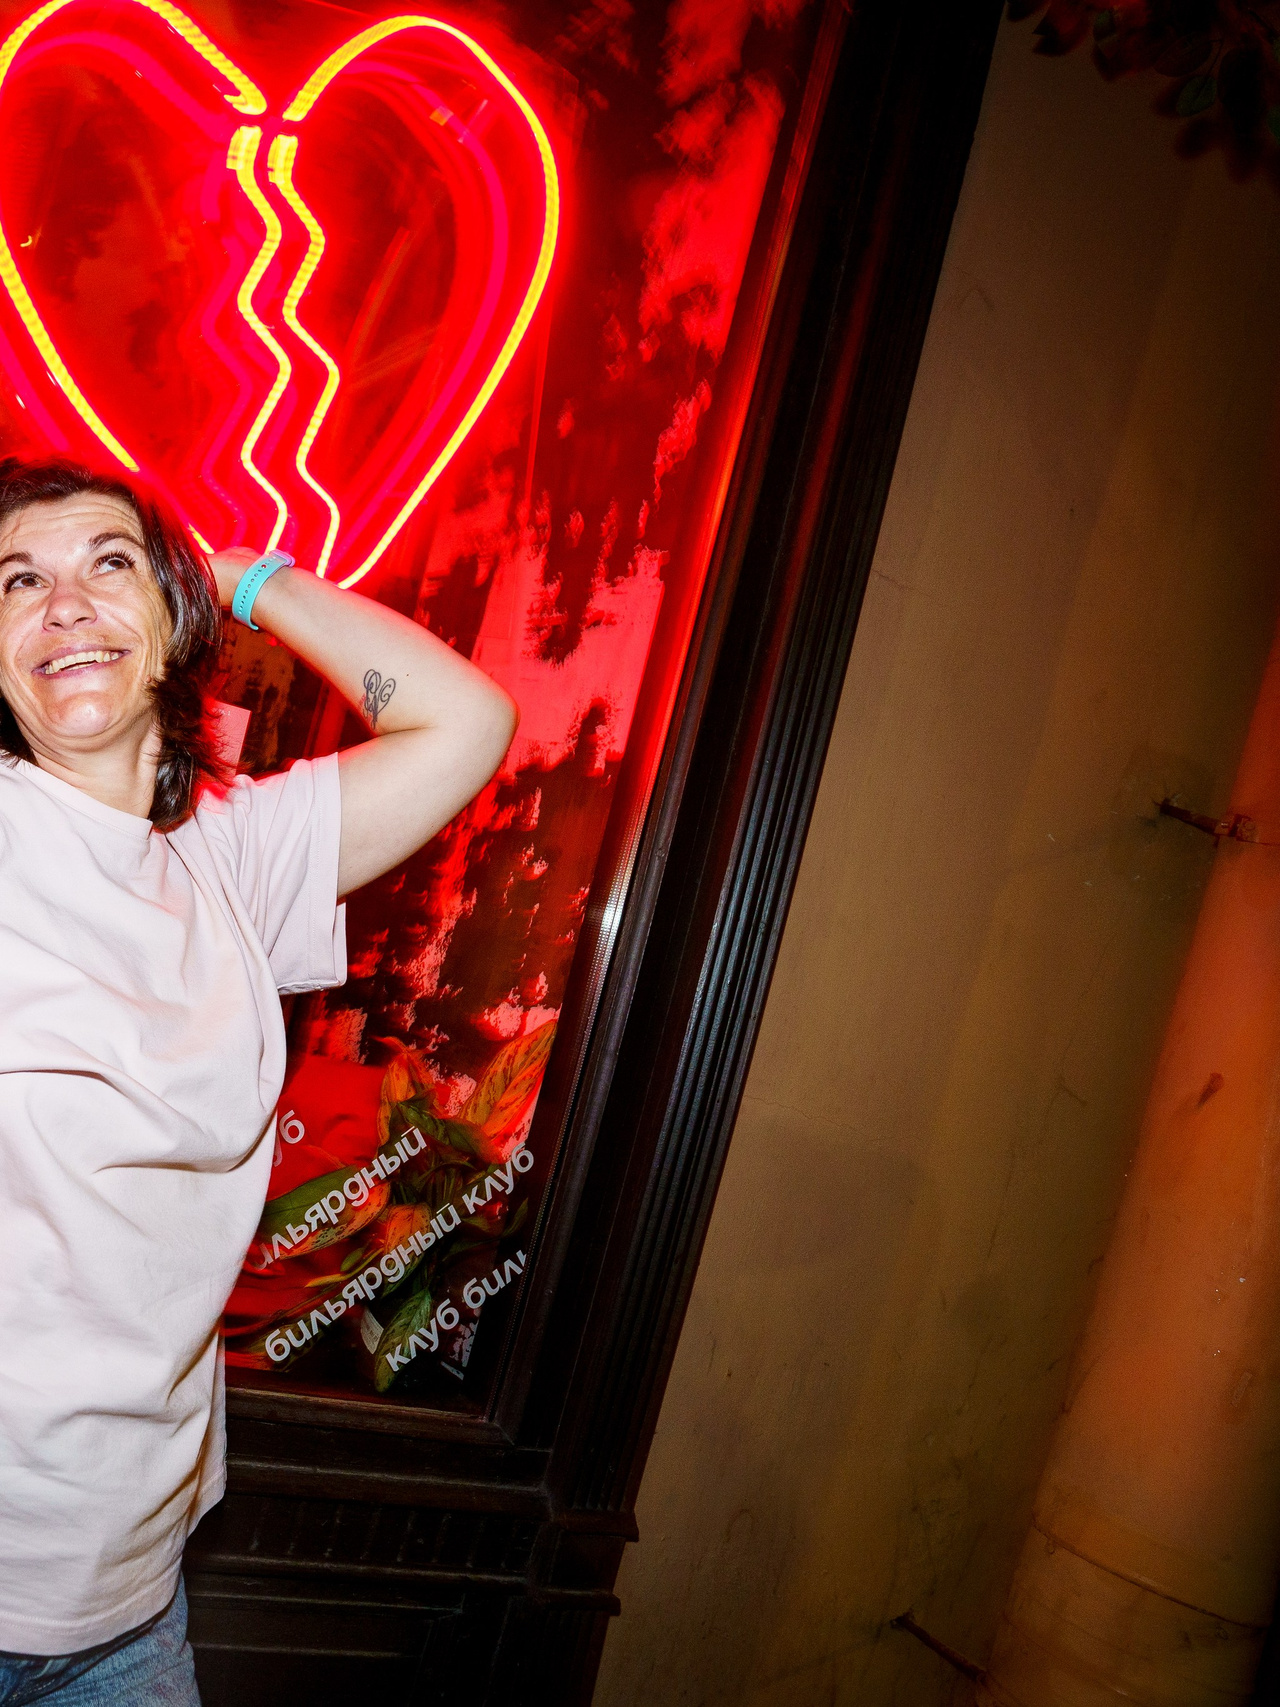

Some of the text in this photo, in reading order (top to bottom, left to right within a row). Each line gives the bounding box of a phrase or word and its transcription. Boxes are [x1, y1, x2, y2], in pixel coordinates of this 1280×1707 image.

[265, 1142, 535, 1362] бильярдный клуб
[385, 1298, 460, 1372] клуб
